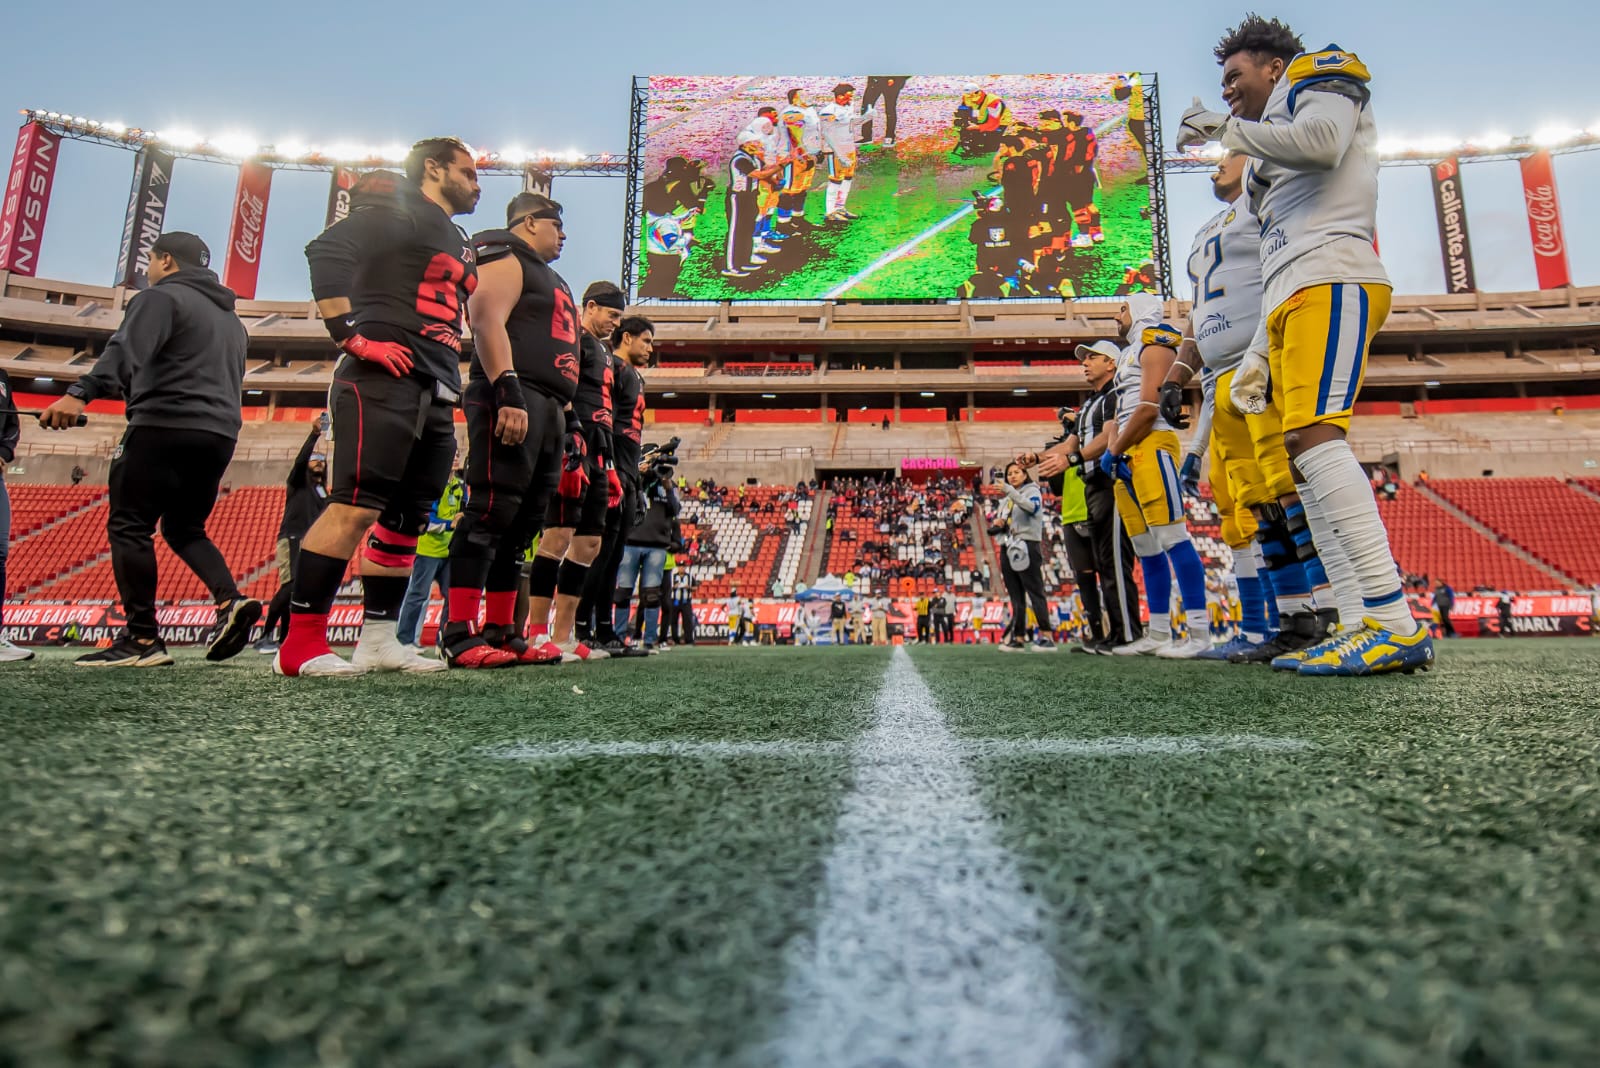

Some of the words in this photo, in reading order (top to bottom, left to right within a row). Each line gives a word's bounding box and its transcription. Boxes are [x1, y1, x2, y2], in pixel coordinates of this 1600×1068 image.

[14, 134, 54, 273] NISSAN
[134, 190, 164, 276] AFIRME
[2, 609, 41, 625] AMOS
[41, 609, 93, 625] GALGOS
[1508, 616, 1561, 632] HARLY
